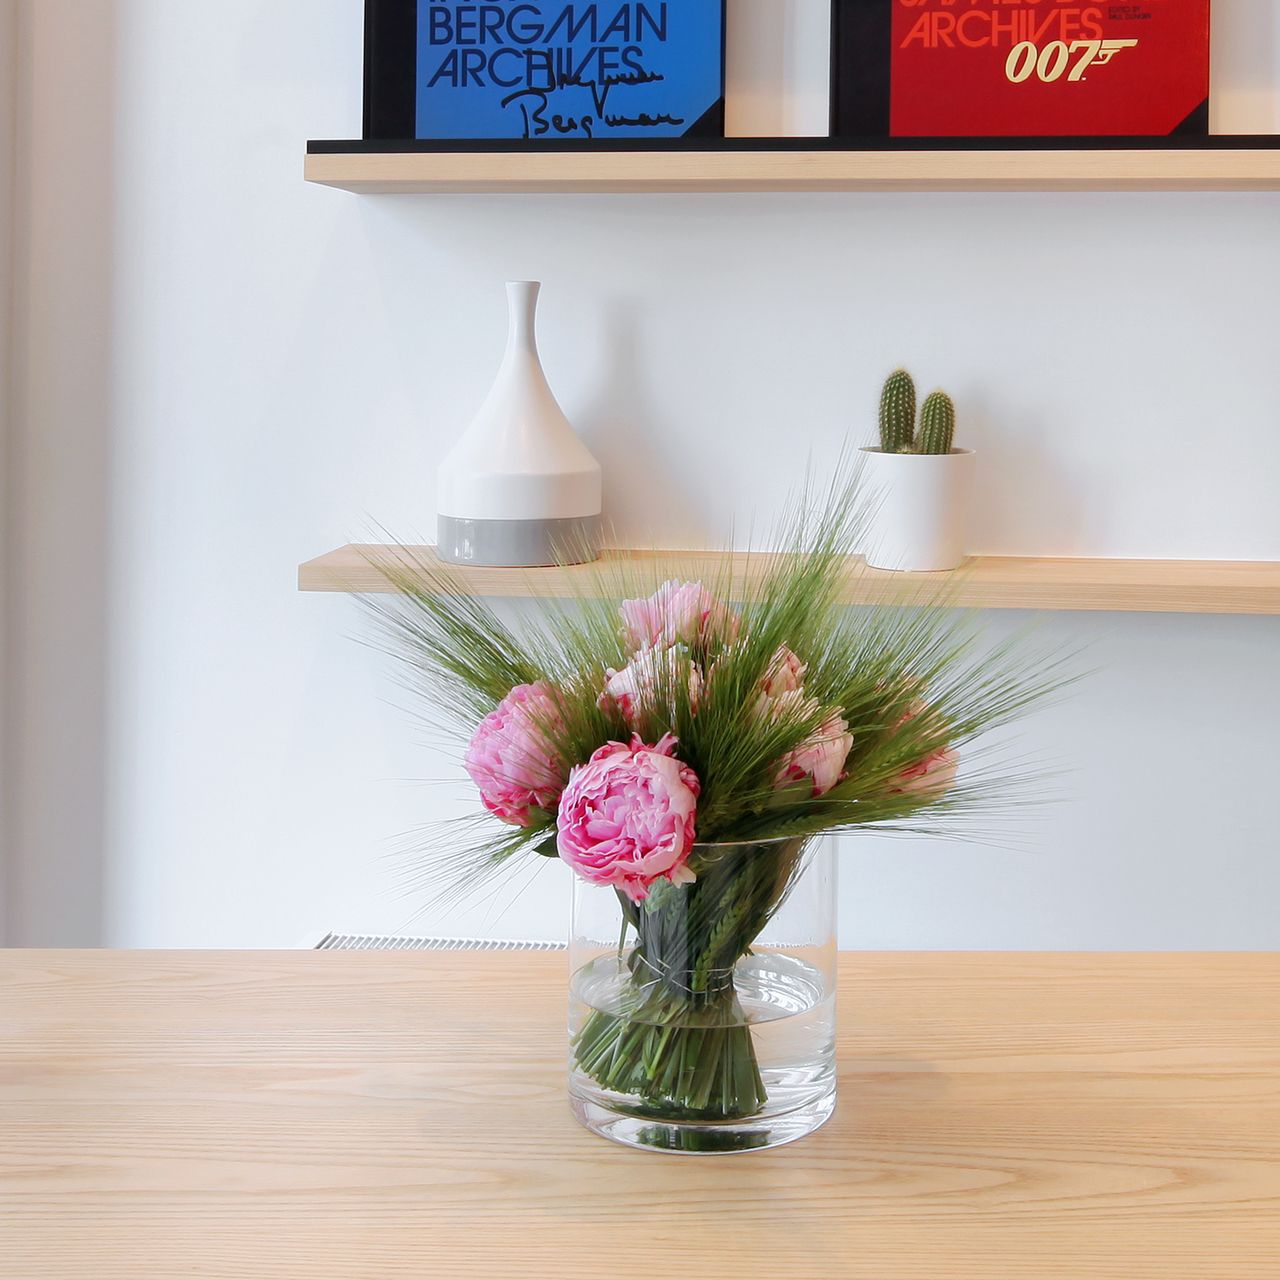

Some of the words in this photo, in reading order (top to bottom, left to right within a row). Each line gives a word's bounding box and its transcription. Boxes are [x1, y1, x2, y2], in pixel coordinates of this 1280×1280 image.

[429, 3, 667, 45] BERGMAN
[899, 6, 1104, 49] ARCHIVES
[426, 46, 645, 88] ARCHIVES
[1005, 39, 1102, 83] 007
